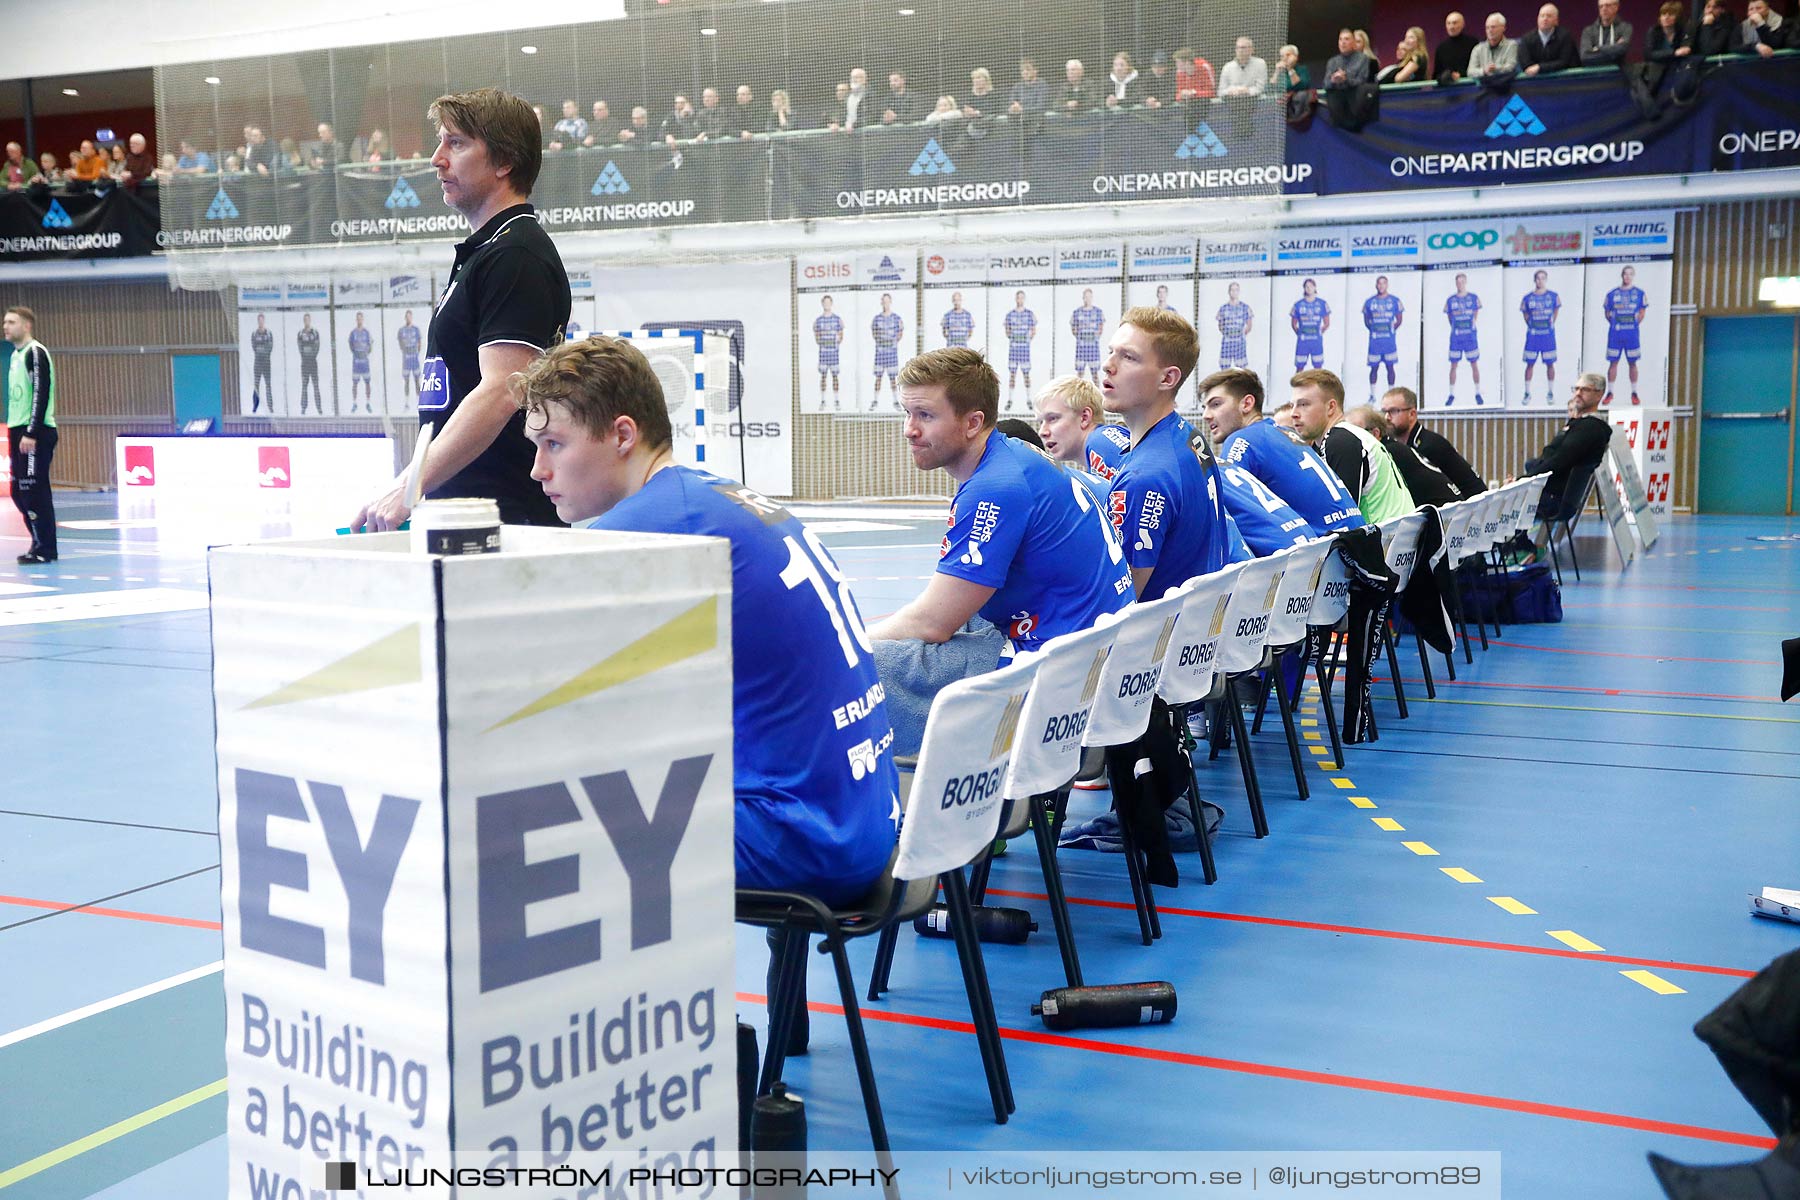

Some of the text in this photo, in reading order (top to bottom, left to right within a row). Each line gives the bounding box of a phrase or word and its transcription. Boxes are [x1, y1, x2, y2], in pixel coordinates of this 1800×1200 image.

[1391, 140, 1644, 177] ONEPARTNERGROUP
[837, 181, 1030, 209] ONEPARTNERGROUP
[1093, 164, 1312, 193] ONEPARTNERGROUP
[156, 225, 291, 245] ONEPARTNERGROUP
[1279, 238, 1341, 250] SALMING
[1352, 234, 1417, 247] SALMING
[1427, 229, 1498, 250] coop
[1593, 222, 1667, 236] SALMING
[970, 500, 990, 540] INTER
[981, 502, 1001, 543] SPORT
[1139, 490, 1158, 527] INTER
[1149, 492, 1166, 529] SPORT
[234, 767, 422, 987] EY
[477, 753, 715, 994] EY
[241, 992, 428, 1129] Building
[481, 987, 716, 1109] Building
[245, 1084, 425, 1180] a better
[483, 1062, 713, 1175] a better
